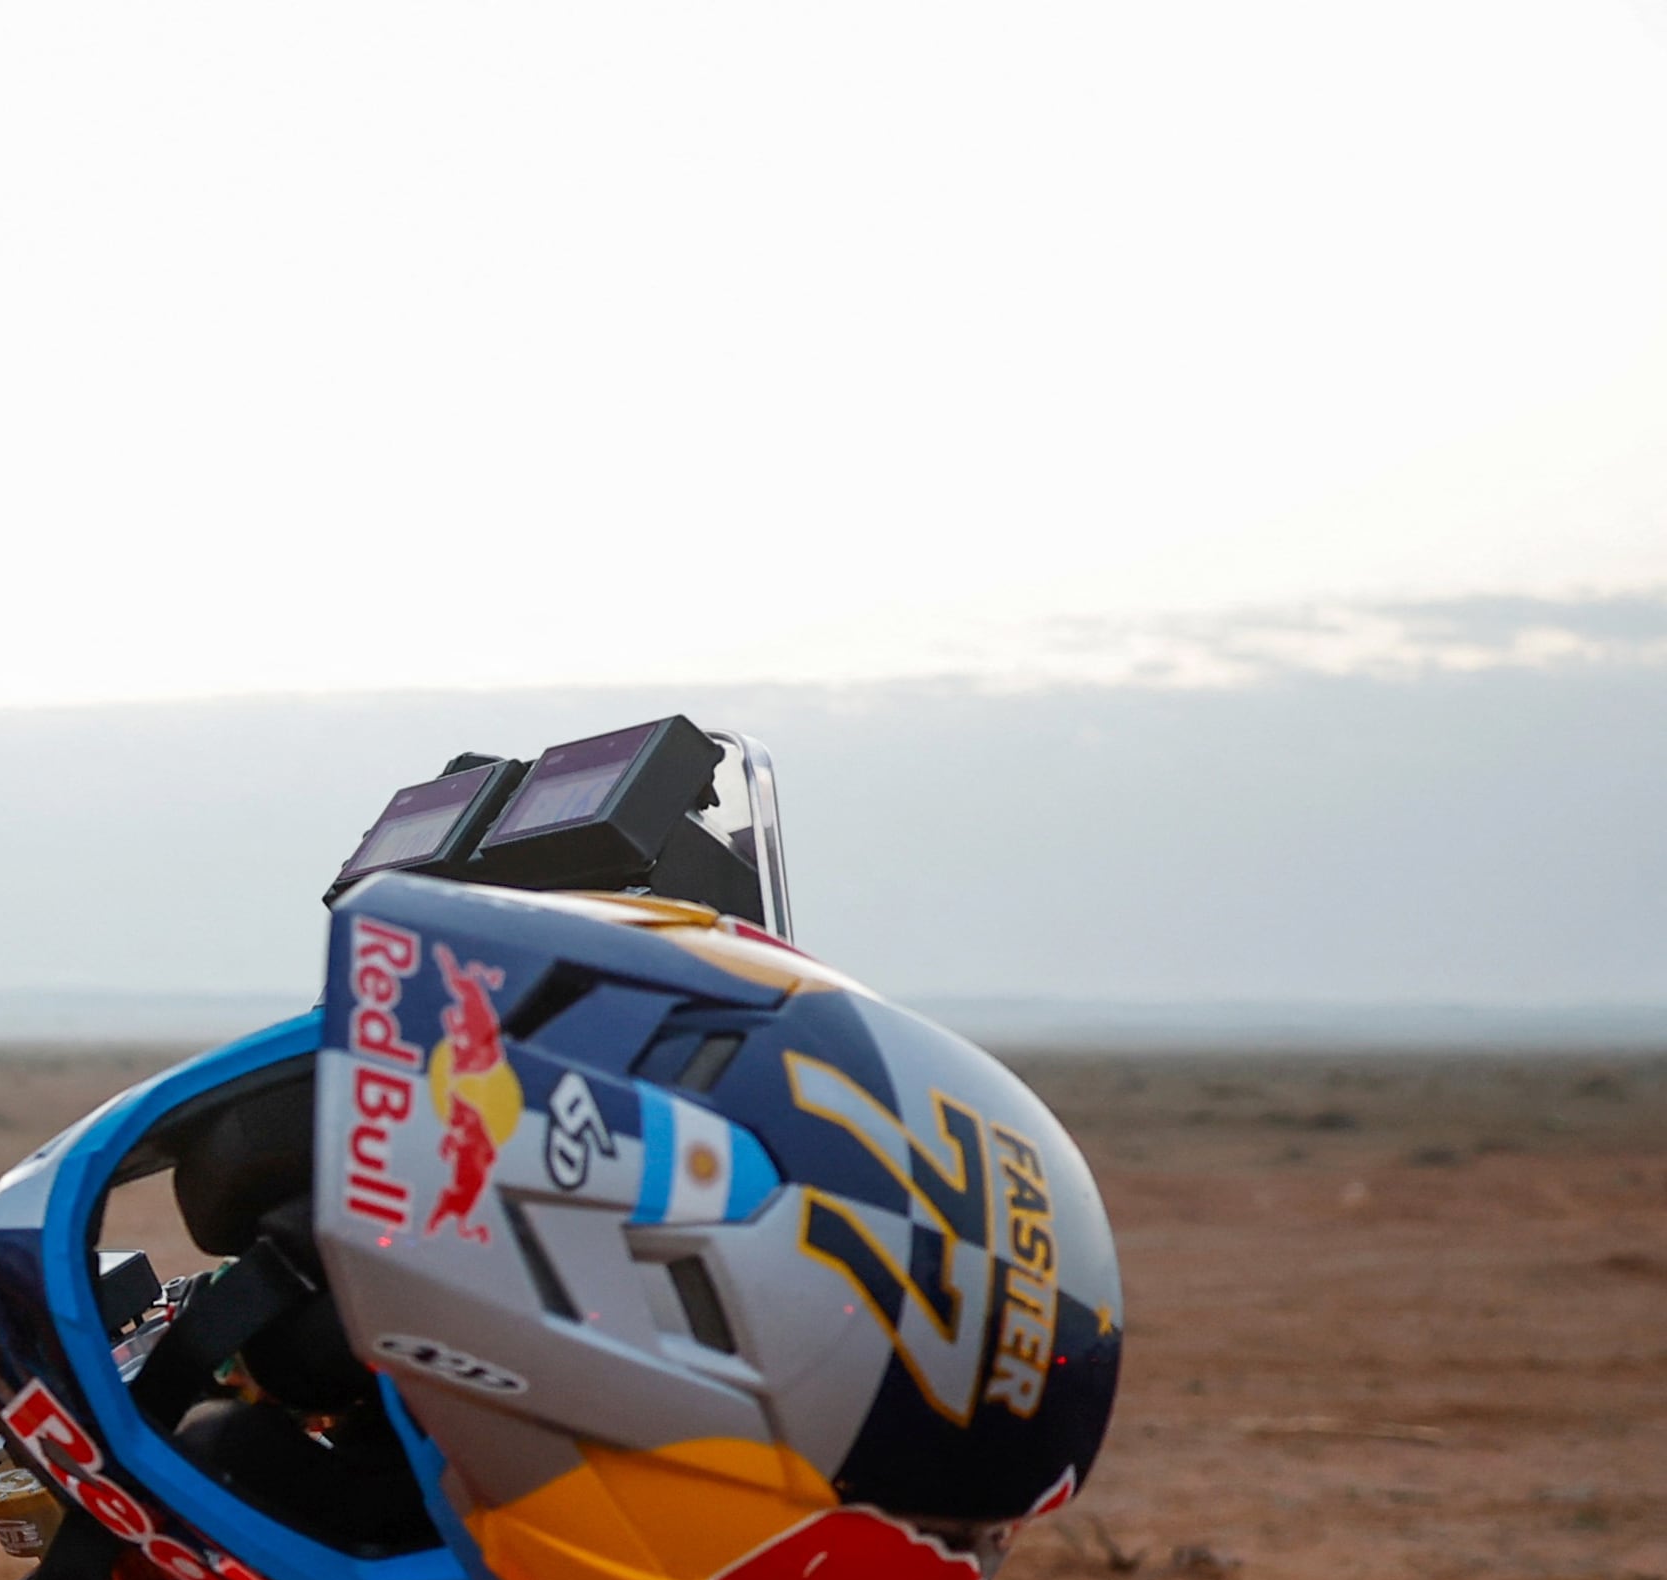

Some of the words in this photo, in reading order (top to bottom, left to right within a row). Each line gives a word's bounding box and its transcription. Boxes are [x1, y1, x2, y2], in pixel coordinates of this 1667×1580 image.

[347, 914, 424, 1070] Red
[345, 1063, 415, 1232] Bull
[985, 1120, 1059, 1420] FASTER
